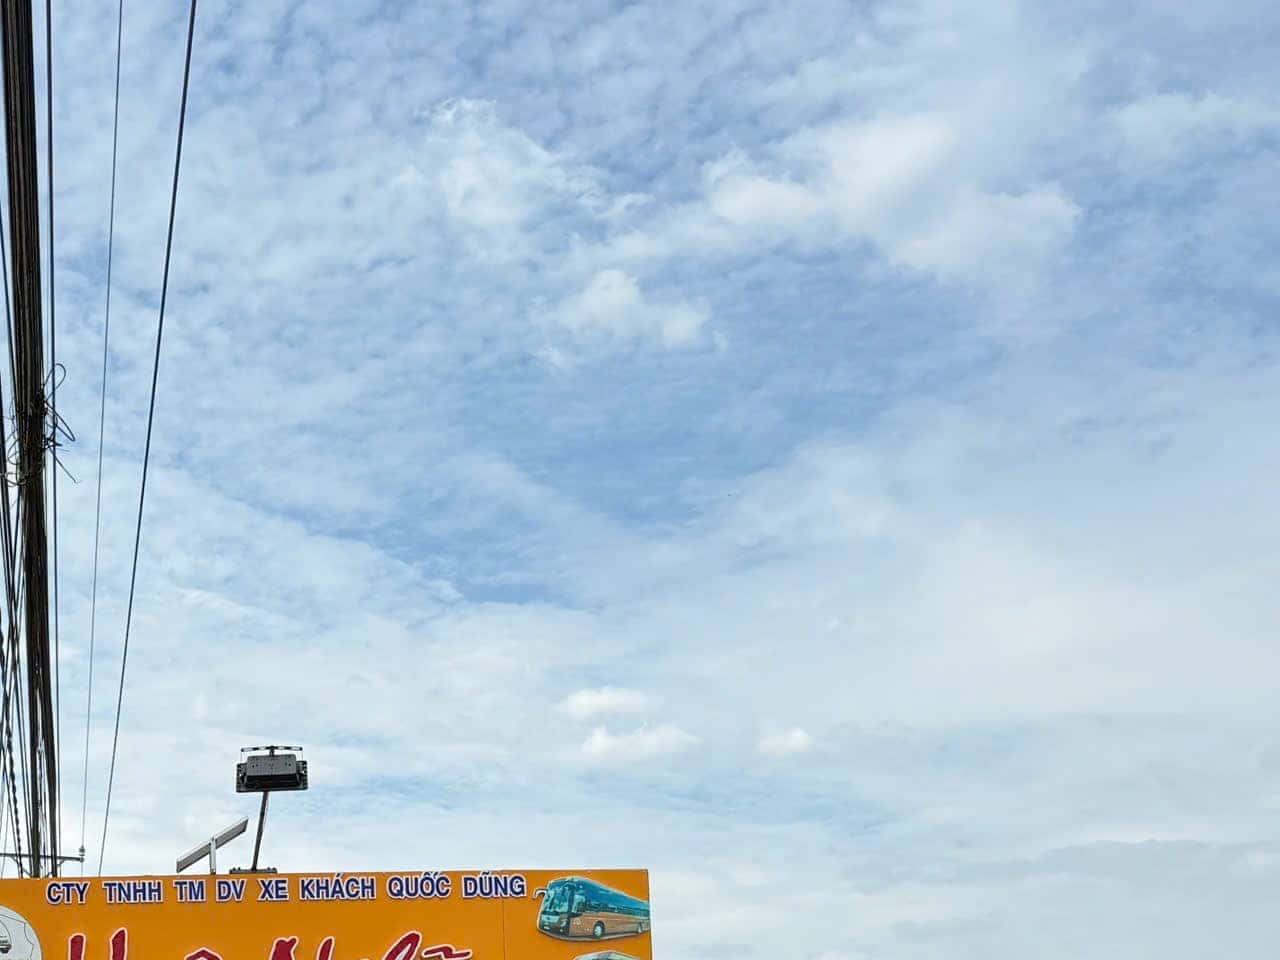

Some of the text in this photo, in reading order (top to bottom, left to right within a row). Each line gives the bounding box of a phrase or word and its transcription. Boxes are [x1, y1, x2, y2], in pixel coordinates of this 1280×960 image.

[47, 871, 526, 904] CTY TNHH TM DV XE KHÁCH QUỐC DŨNG
